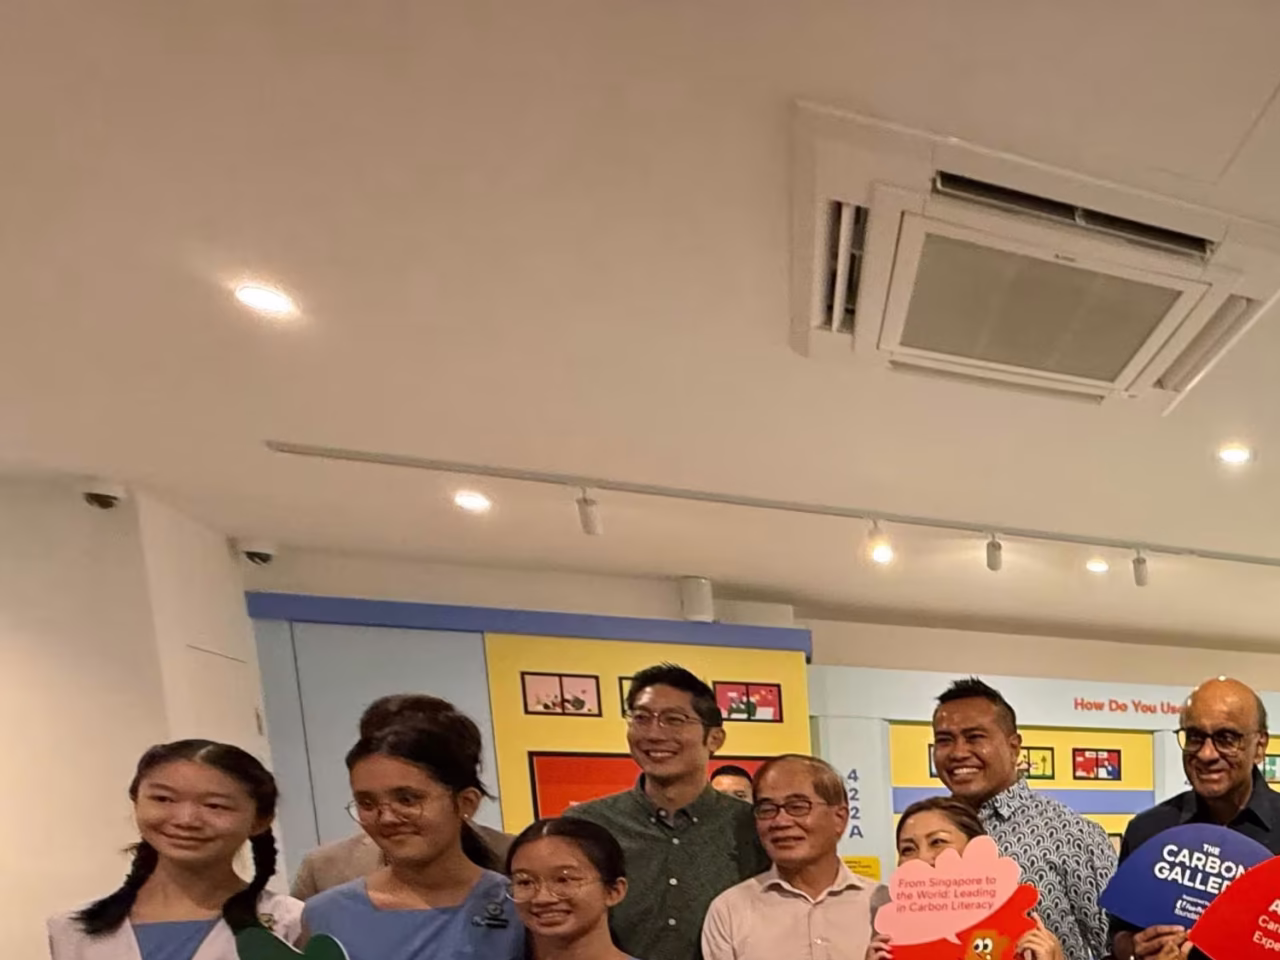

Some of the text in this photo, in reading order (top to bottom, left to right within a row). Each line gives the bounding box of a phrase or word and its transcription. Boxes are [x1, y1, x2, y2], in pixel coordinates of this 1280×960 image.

[1074, 698, 1105, 711] How
[1108, 699, 1128, 712] Do
[1132, 700, 1157, 714] You
[847, 768, 864, 839] 422A
[1203, 843, 1221, 856] THE
[898, 876, 996, 888] From Singapore to
[1154, 861, 1232, 895] GALLE
[896, 888, 996, 900] the World: Leading
[896, 901, 994, 913] in Carbon Literacy
